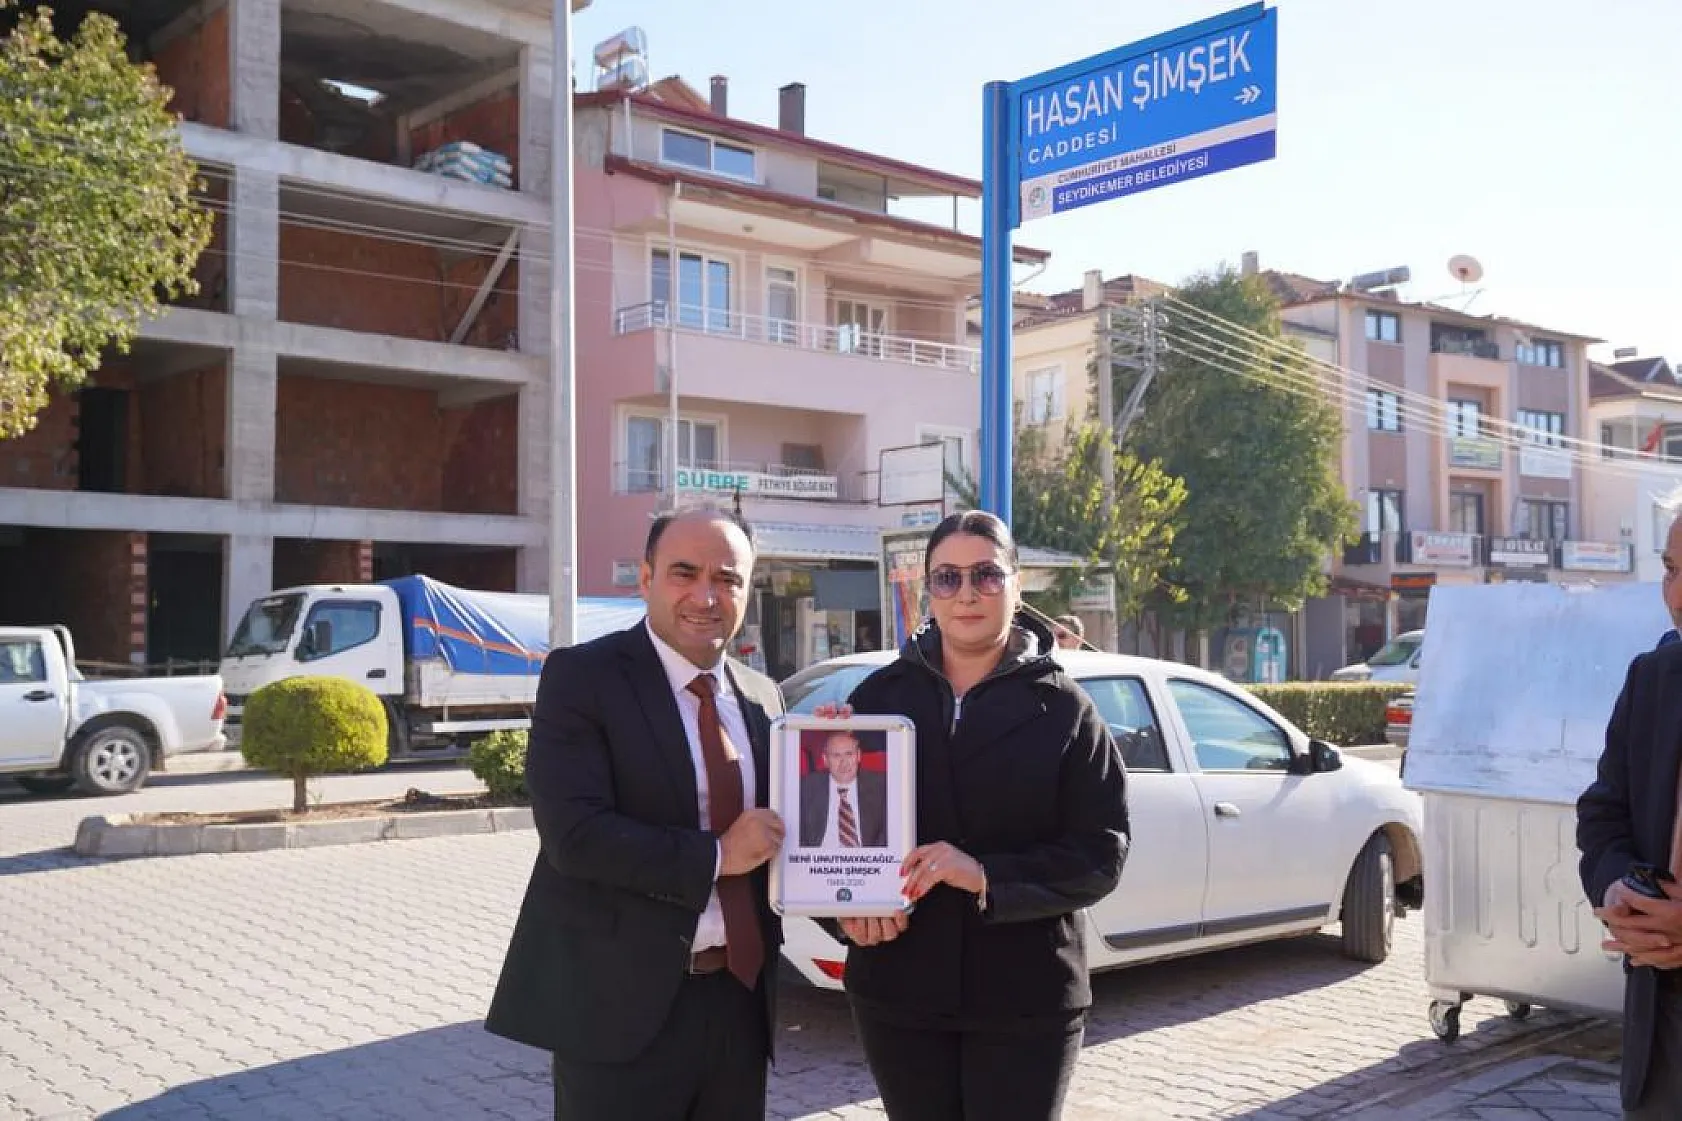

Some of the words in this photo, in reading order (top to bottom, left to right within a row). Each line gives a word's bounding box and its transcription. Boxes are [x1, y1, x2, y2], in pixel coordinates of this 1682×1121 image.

[1027, 71, 1124, 137] HASAN
[1132, 30, 1252, 111] ŞİMŞEK
[1028, 121, 1118, 164] CADDESİ
[1058, 174, 1134, 205] SEYDİKEMER
[1135, 152, 1209, 185] BELEDİYESİ
[809, 865, 843, 875] HASAN
[844, 865, 882, 877] ŞİMŞEK
